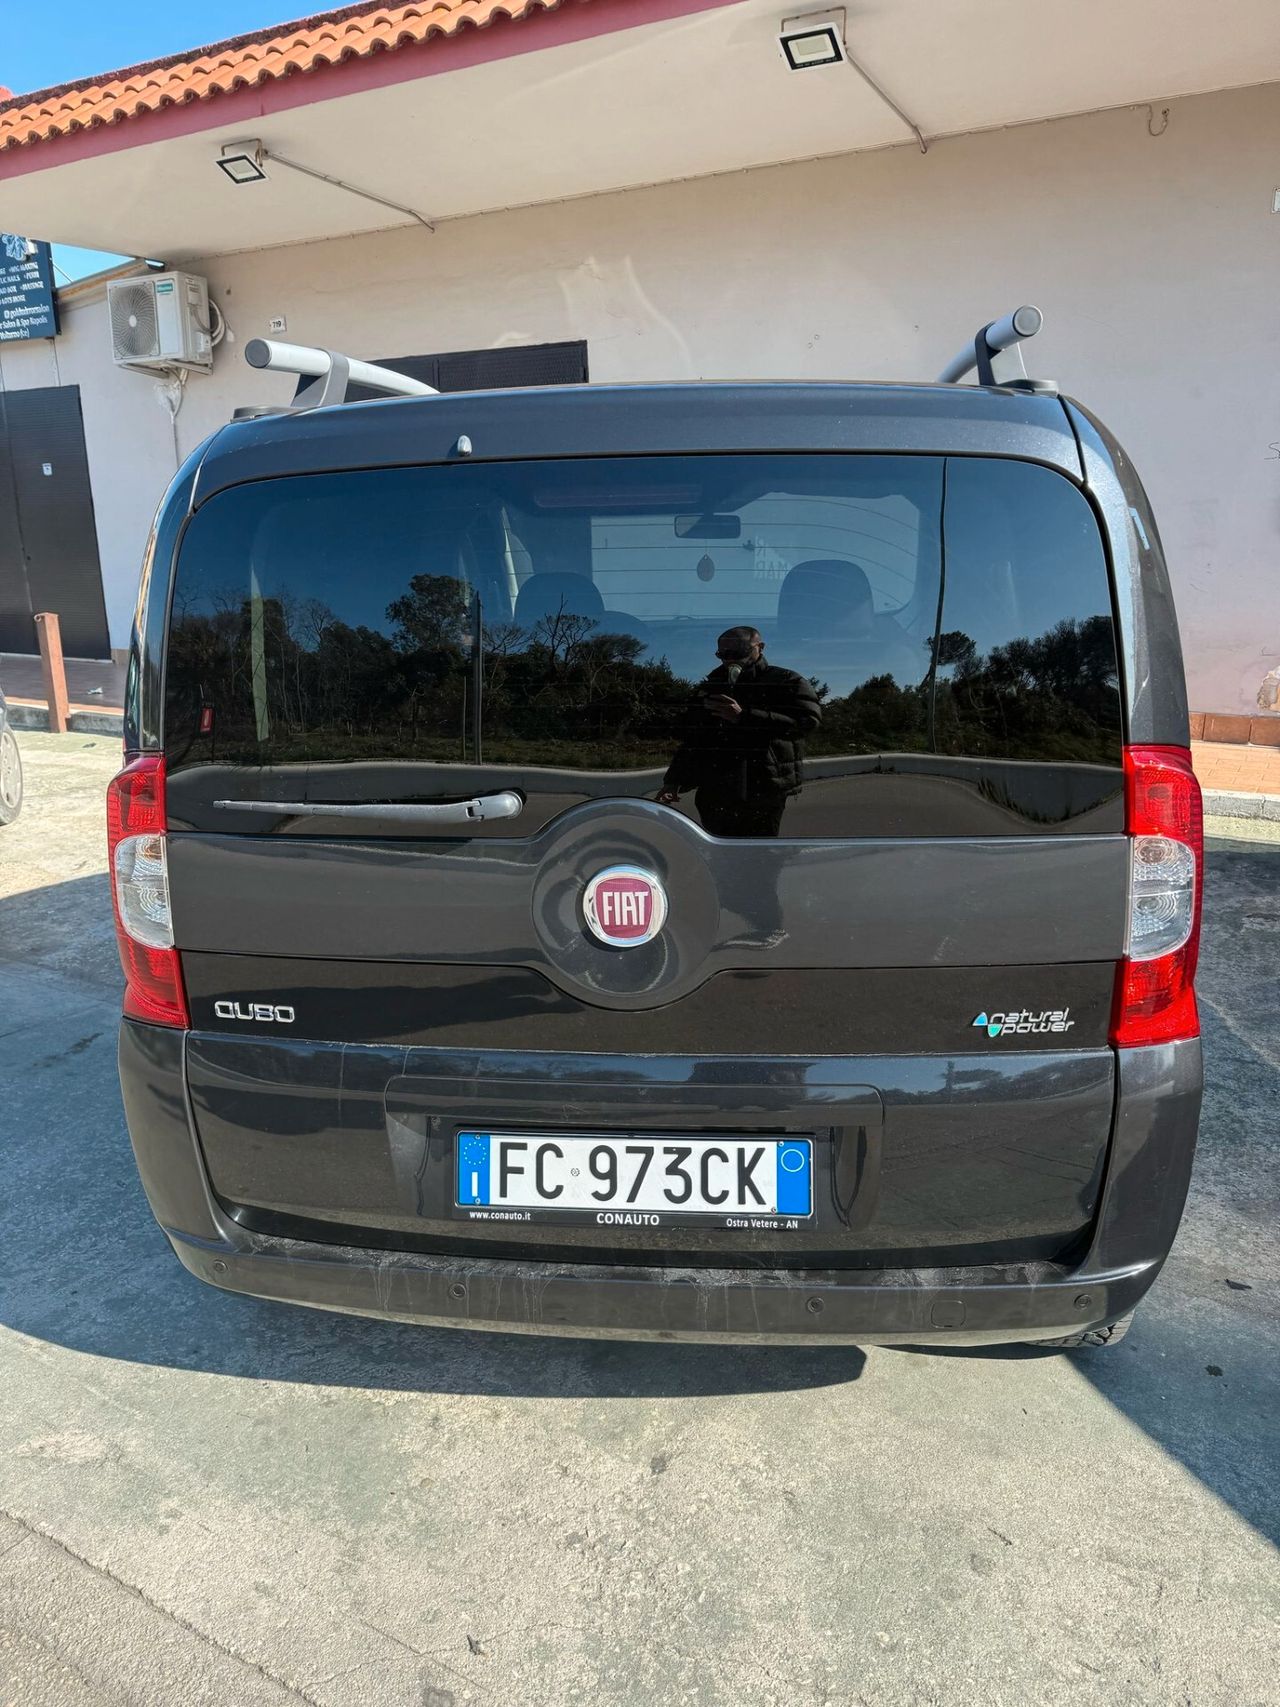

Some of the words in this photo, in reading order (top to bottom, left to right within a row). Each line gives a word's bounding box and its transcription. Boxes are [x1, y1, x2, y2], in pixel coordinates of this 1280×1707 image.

[602, 891, 649, 926] FIAT
[214, 1000, 295, 1024] QUBO
[990, 1007, 1070, 1024] natural
[1000, 1020, 1075, 1037] power
[499, 1141, 565, 1201] FC
[588, 1144, 767, 1206] 973CK
[469, 1210, 531, 1221] www.conauto.it
[596, 1212, 660, 1226] CONAUTO
[726, 1218, 748, 1228] Ostra
[750, 1218, 778, 1229] Vetere
[785, 1219, 799, 1229] AN
